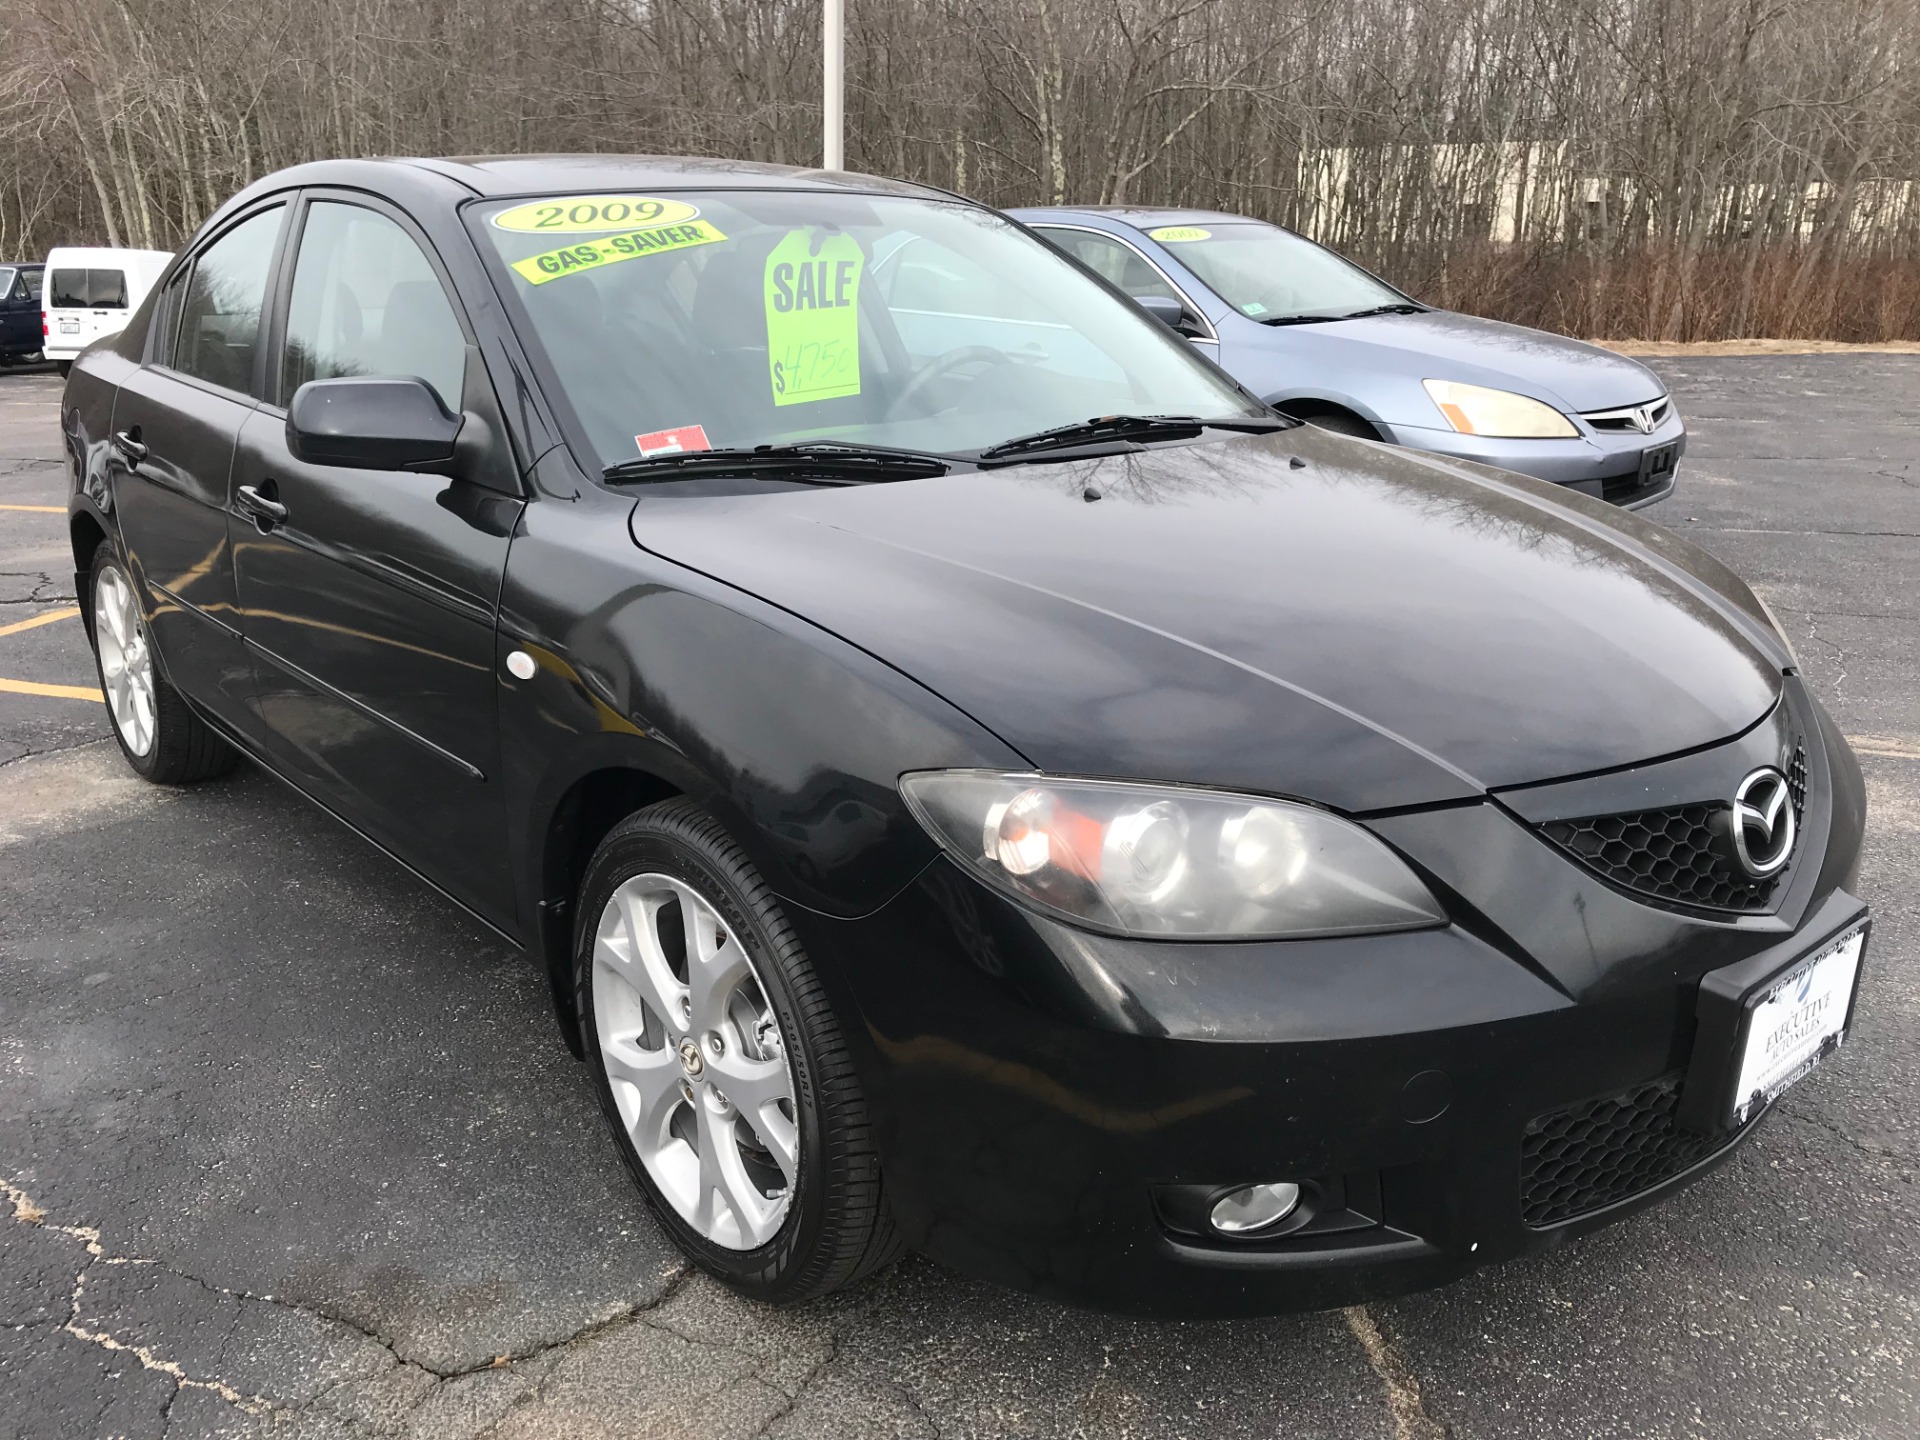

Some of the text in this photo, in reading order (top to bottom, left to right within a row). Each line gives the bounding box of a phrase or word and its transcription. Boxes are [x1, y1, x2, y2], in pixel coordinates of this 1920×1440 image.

[535, 201, 665, 228] 2009
[536, 225, 702, 274] GAS-SAVER
[773, 260, 855, 313] SALE
[1765, 990, 1831, 1053] EXECUTIVE
